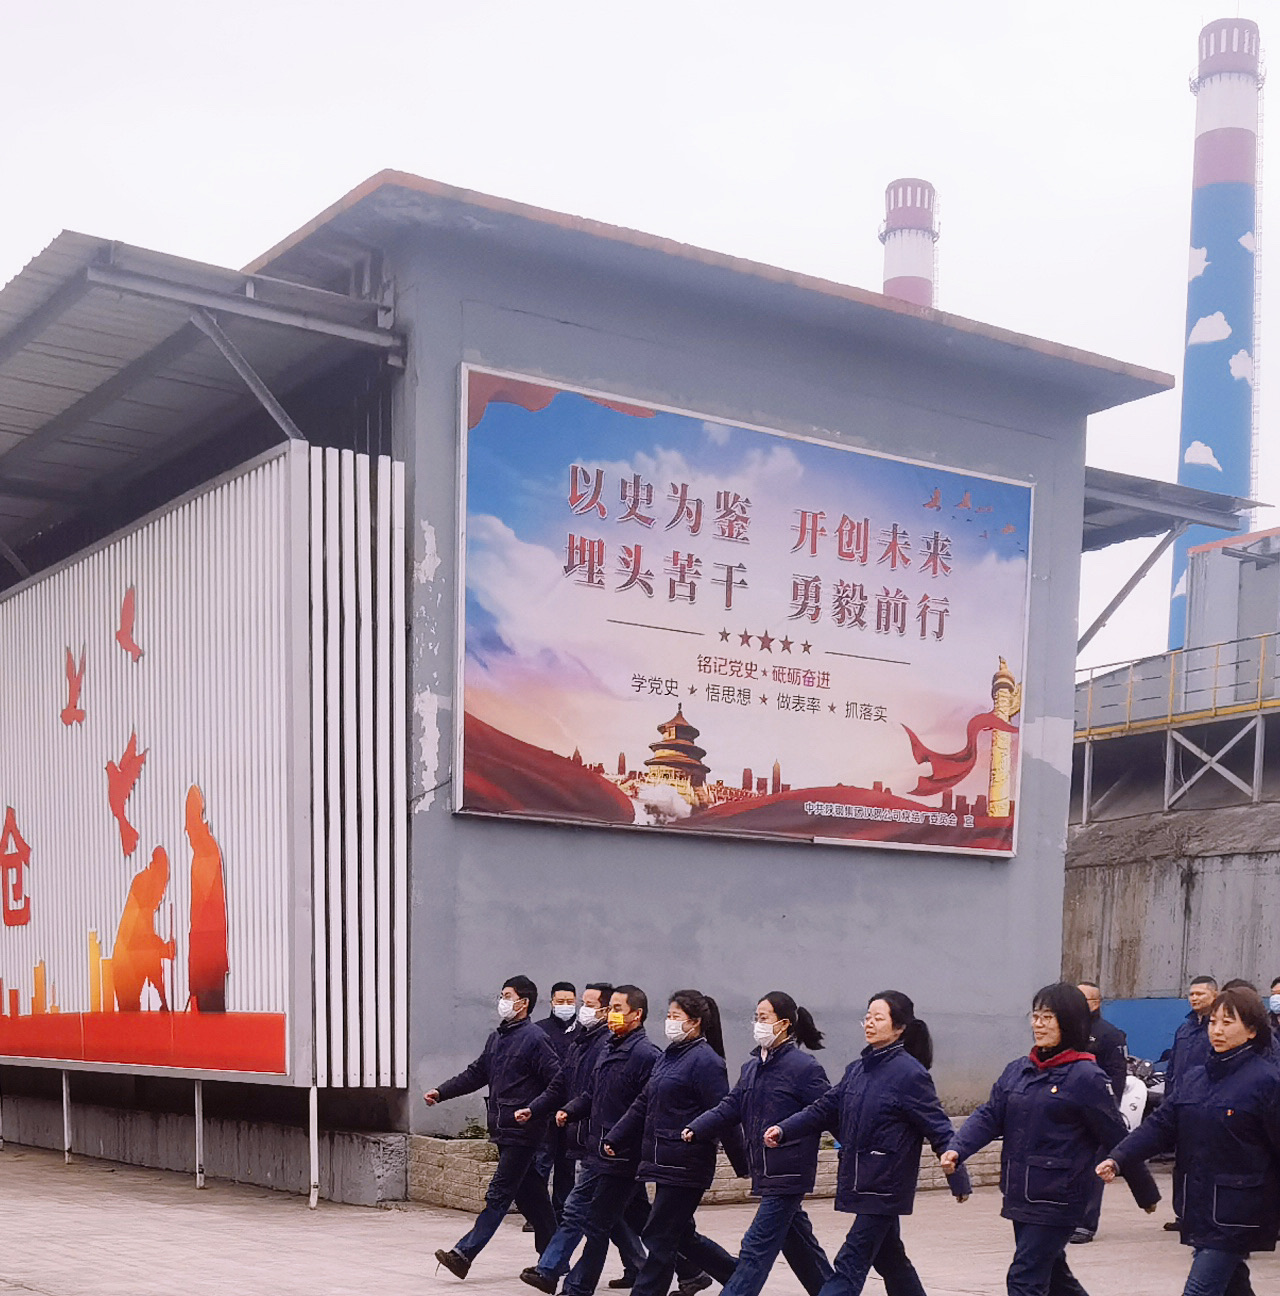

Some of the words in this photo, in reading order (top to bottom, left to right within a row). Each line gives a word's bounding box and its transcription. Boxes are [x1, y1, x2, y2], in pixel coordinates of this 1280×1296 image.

[568, 464, 752, 545] 以史为鉴
[790, 509, 952, 578] 开创未来
[563, 533, 749, 610] 埋头苦干
[787, 573, 951, 641] 勇毅前行
[631, 673, 679, 697] 学党史
[706, 683, 751, 706] 悟思想
[777, 692, 821, 714] 做表率
[845, 701, 888, 723] 抓落实
[697, 654, 759, 680] 铭记党史
[772, 665, 831, 689] 砥砺奋进
